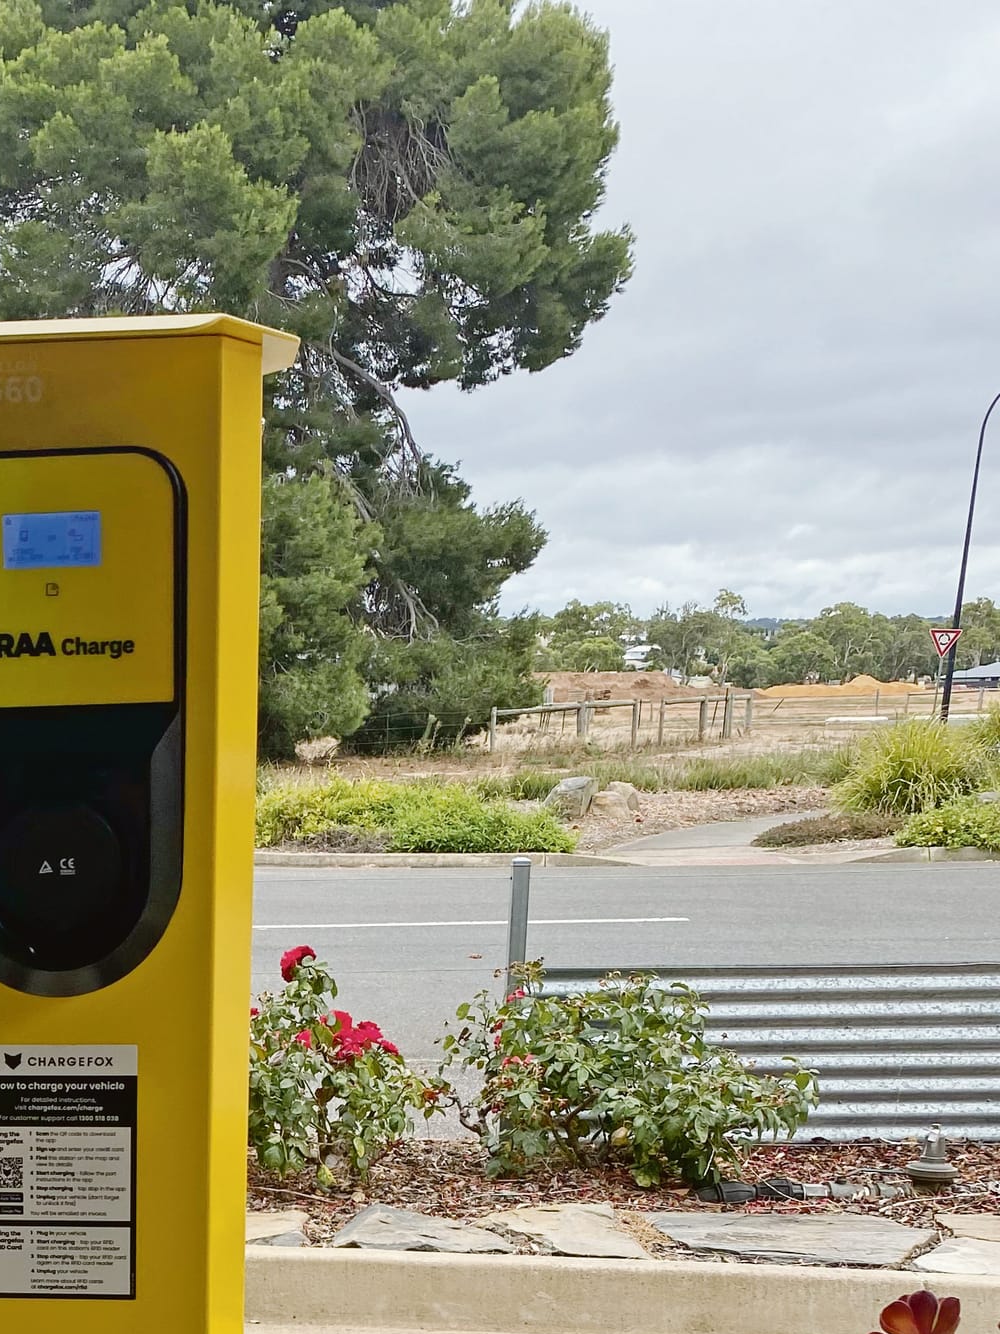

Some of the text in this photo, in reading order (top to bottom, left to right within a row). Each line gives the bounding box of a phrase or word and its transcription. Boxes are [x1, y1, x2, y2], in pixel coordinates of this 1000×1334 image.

[61, 637, 135, 659] Charge
[60, 857, 75, 869] CE
[27, 1056, 114, 1067] CHARGEFOX
[16, 1082, 27, 1090] to
[28, 1081, 63, 1092] charge
[65, 1083, 87, 1092] your
[89, 1081, 125, 1091] vehicle
[28, 1104, 103, 1112] chargefox.com/charge
